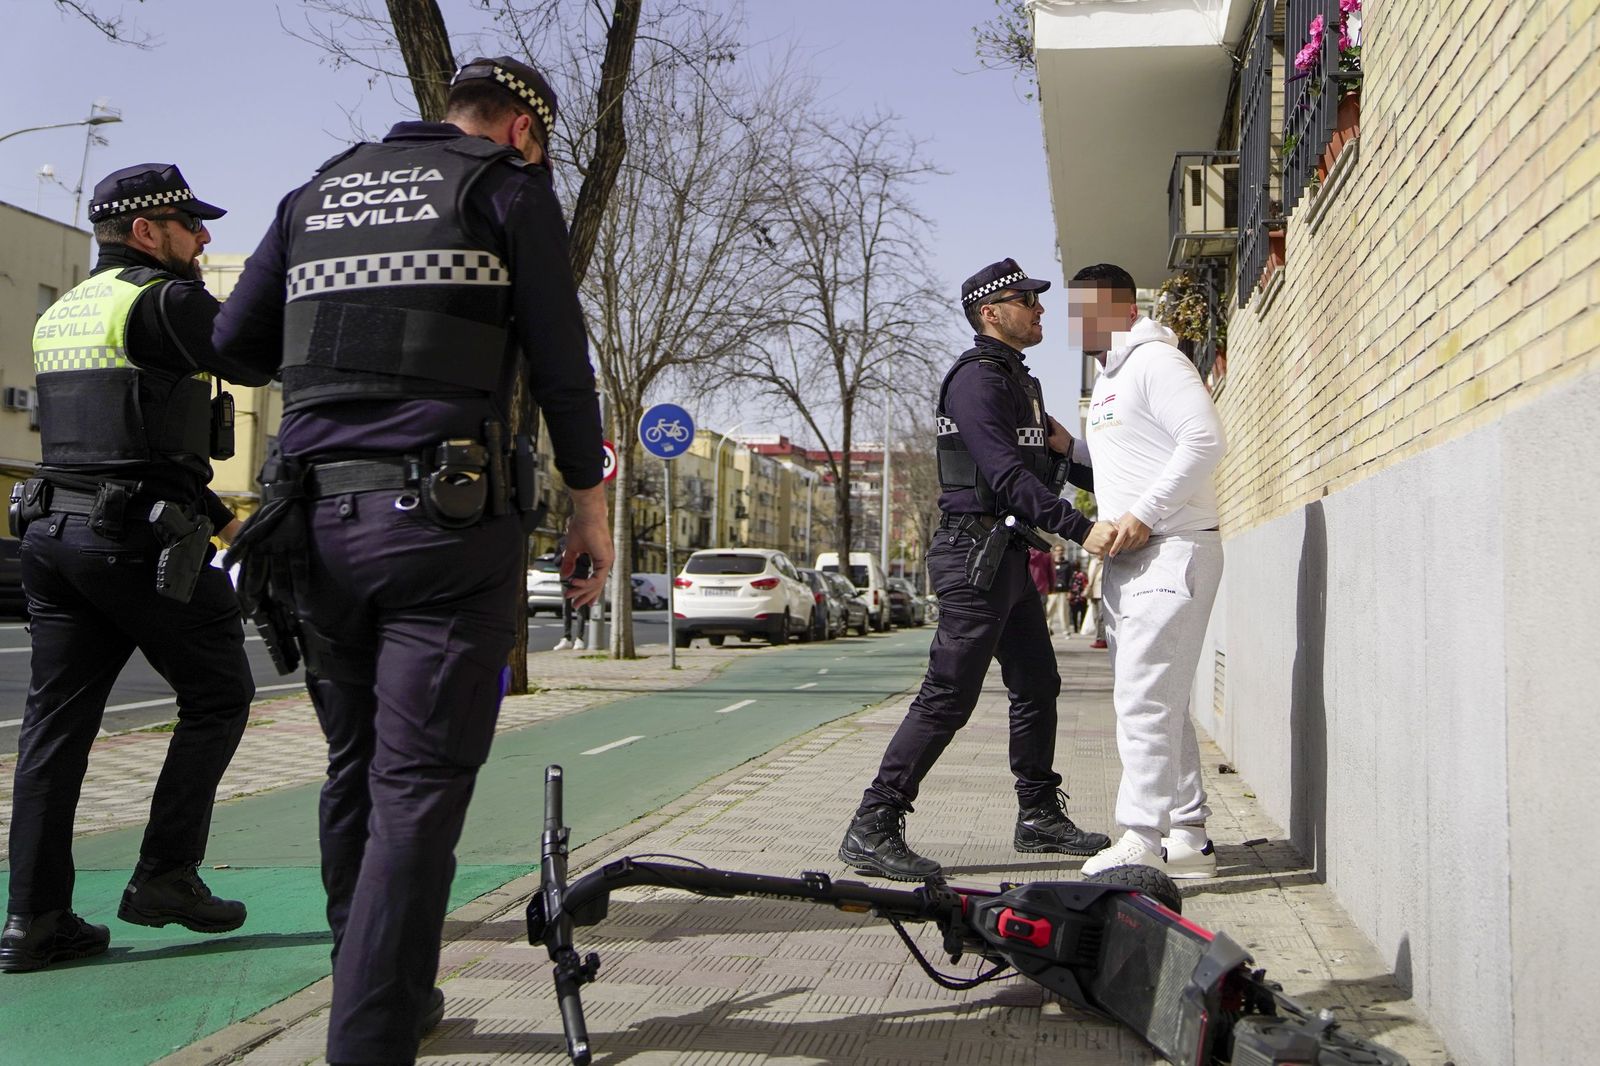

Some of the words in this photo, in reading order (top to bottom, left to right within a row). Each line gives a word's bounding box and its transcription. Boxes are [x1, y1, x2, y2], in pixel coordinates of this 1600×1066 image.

[319, 167, 443, 191] POLICÍA
[322, 186, 427, 209] LOCAL
[305, 204, 439, 232] SEVILLA
[59, 283, 113, 303] OLICÍA
[49, 304, 102, 321] LOCAL
[37, 321, 106, 339] SEVILLA
